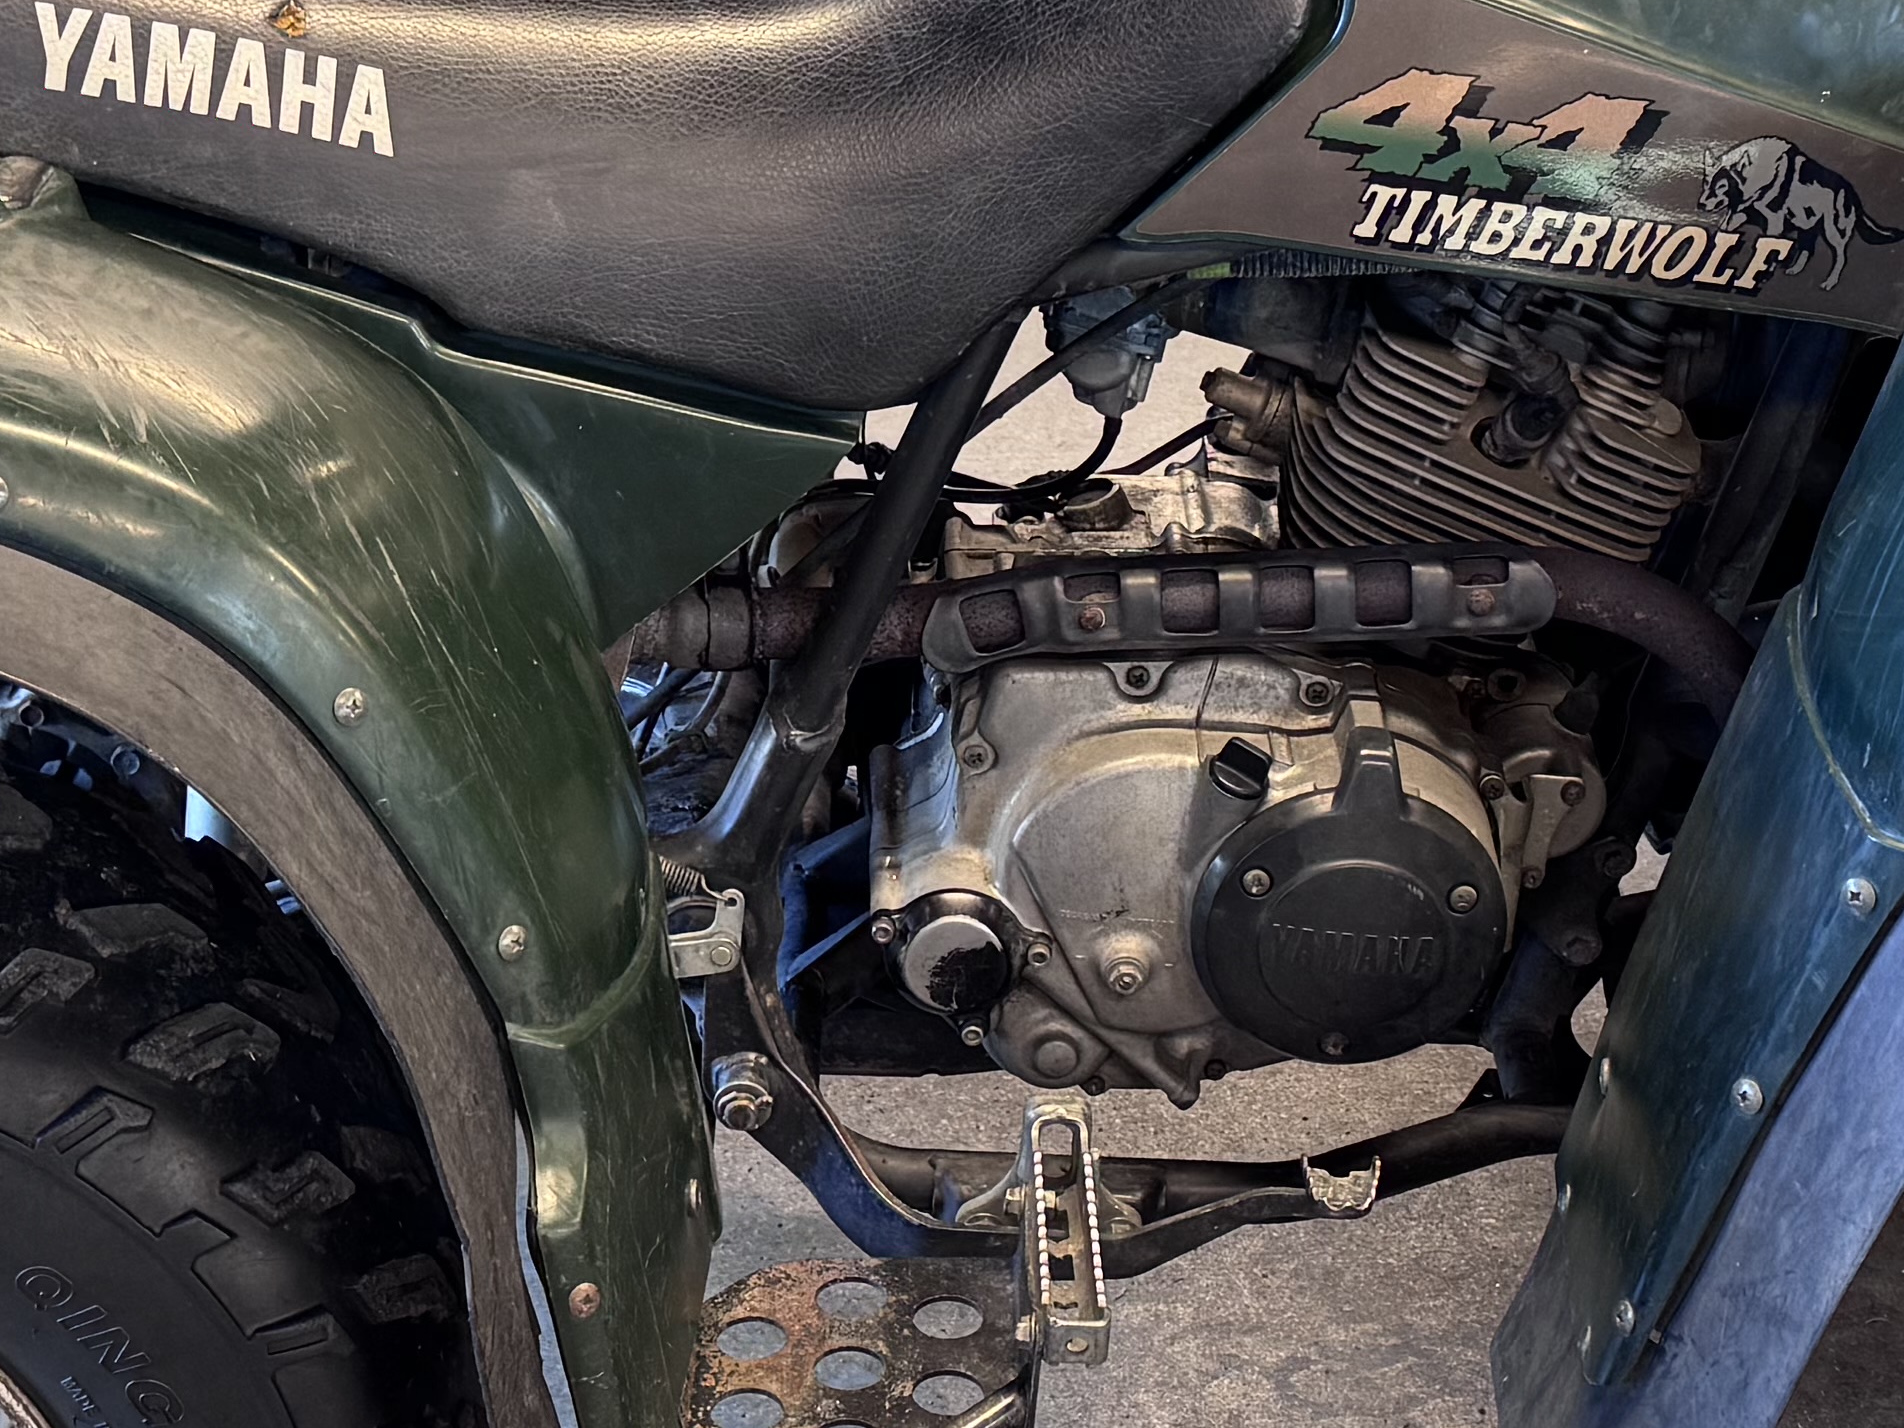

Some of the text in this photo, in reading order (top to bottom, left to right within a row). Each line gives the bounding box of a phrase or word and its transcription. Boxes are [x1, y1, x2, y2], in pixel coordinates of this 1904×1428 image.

[34, 1, 395, 157] YAMAHA
[1352, 183, 1794, 290] TIMBERWOLF
[1268, 923, 1436, 974] YAMAHA
